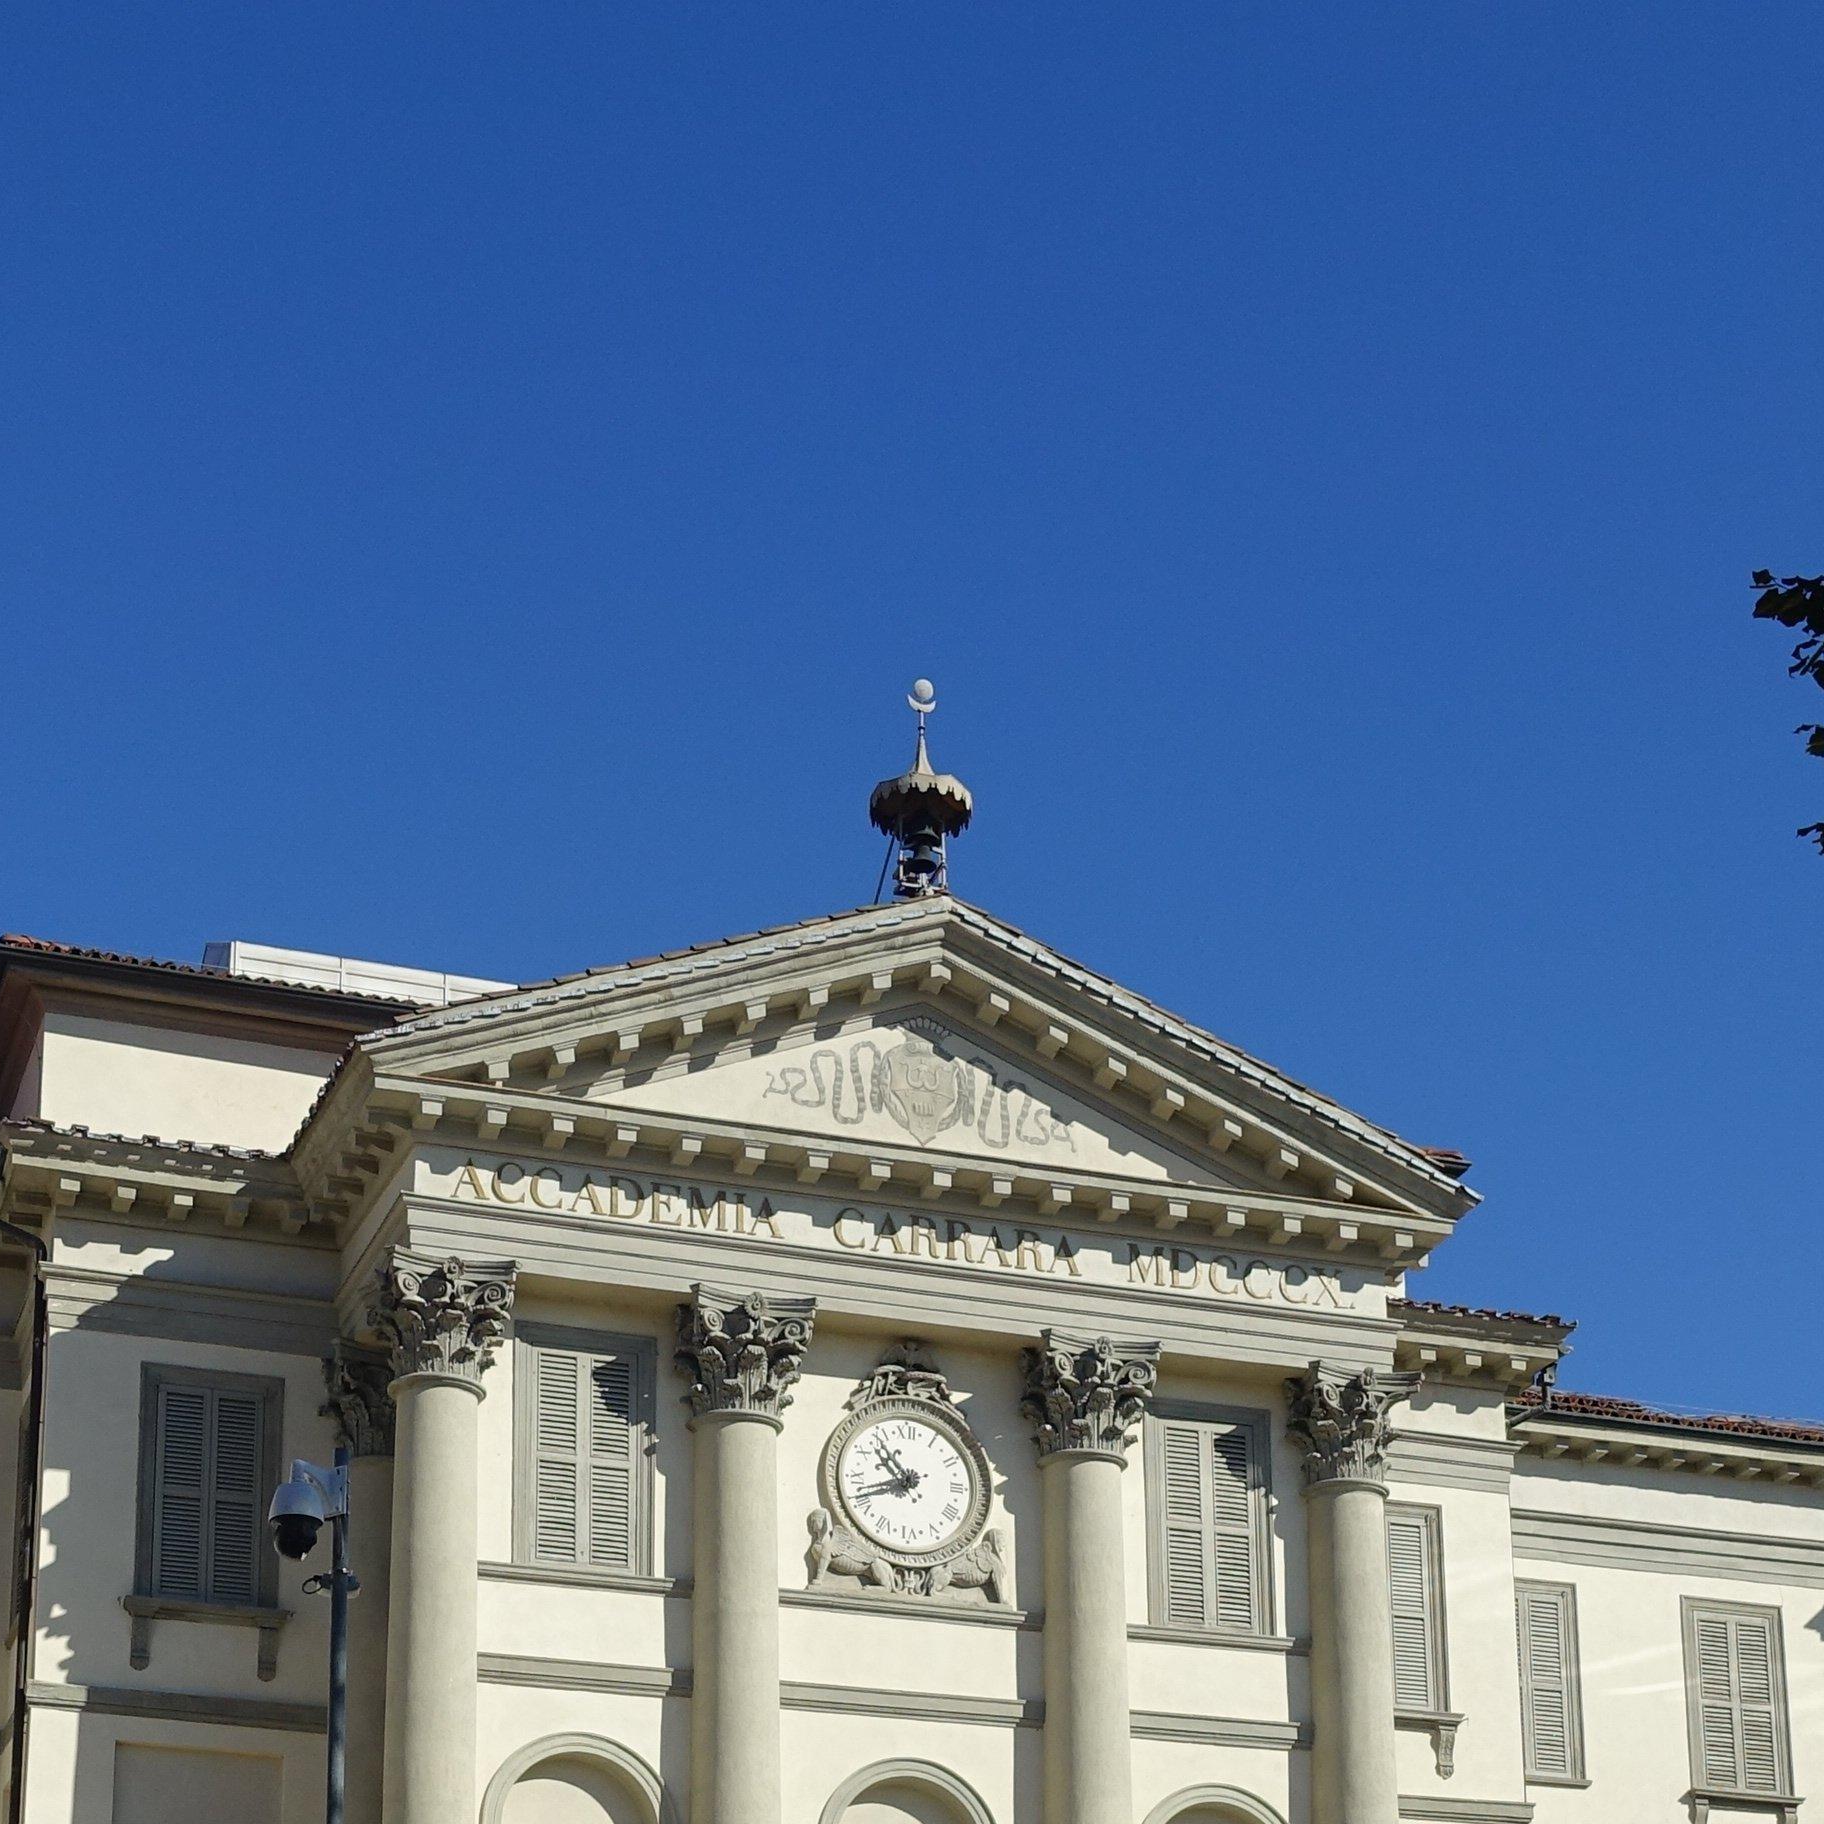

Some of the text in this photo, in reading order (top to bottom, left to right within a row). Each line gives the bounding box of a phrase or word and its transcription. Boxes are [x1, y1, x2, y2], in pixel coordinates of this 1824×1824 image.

[449, 1156, 785, 1240] ACCADEMIA
[832, 1206, 1082, 1278] CARRARA
[896, 1424, 917, 1441] XII
[927, 1433, 938, 1449] I
[856, 1444, 872, 1461] X
[942, 1455, 958, 1469] II
[949, 1481, 964, 1496] III
[875, 1514, 892, 1535] VII
[901, 1525, 917, 1540] VI
[928, 1522, 940, 1538] V
